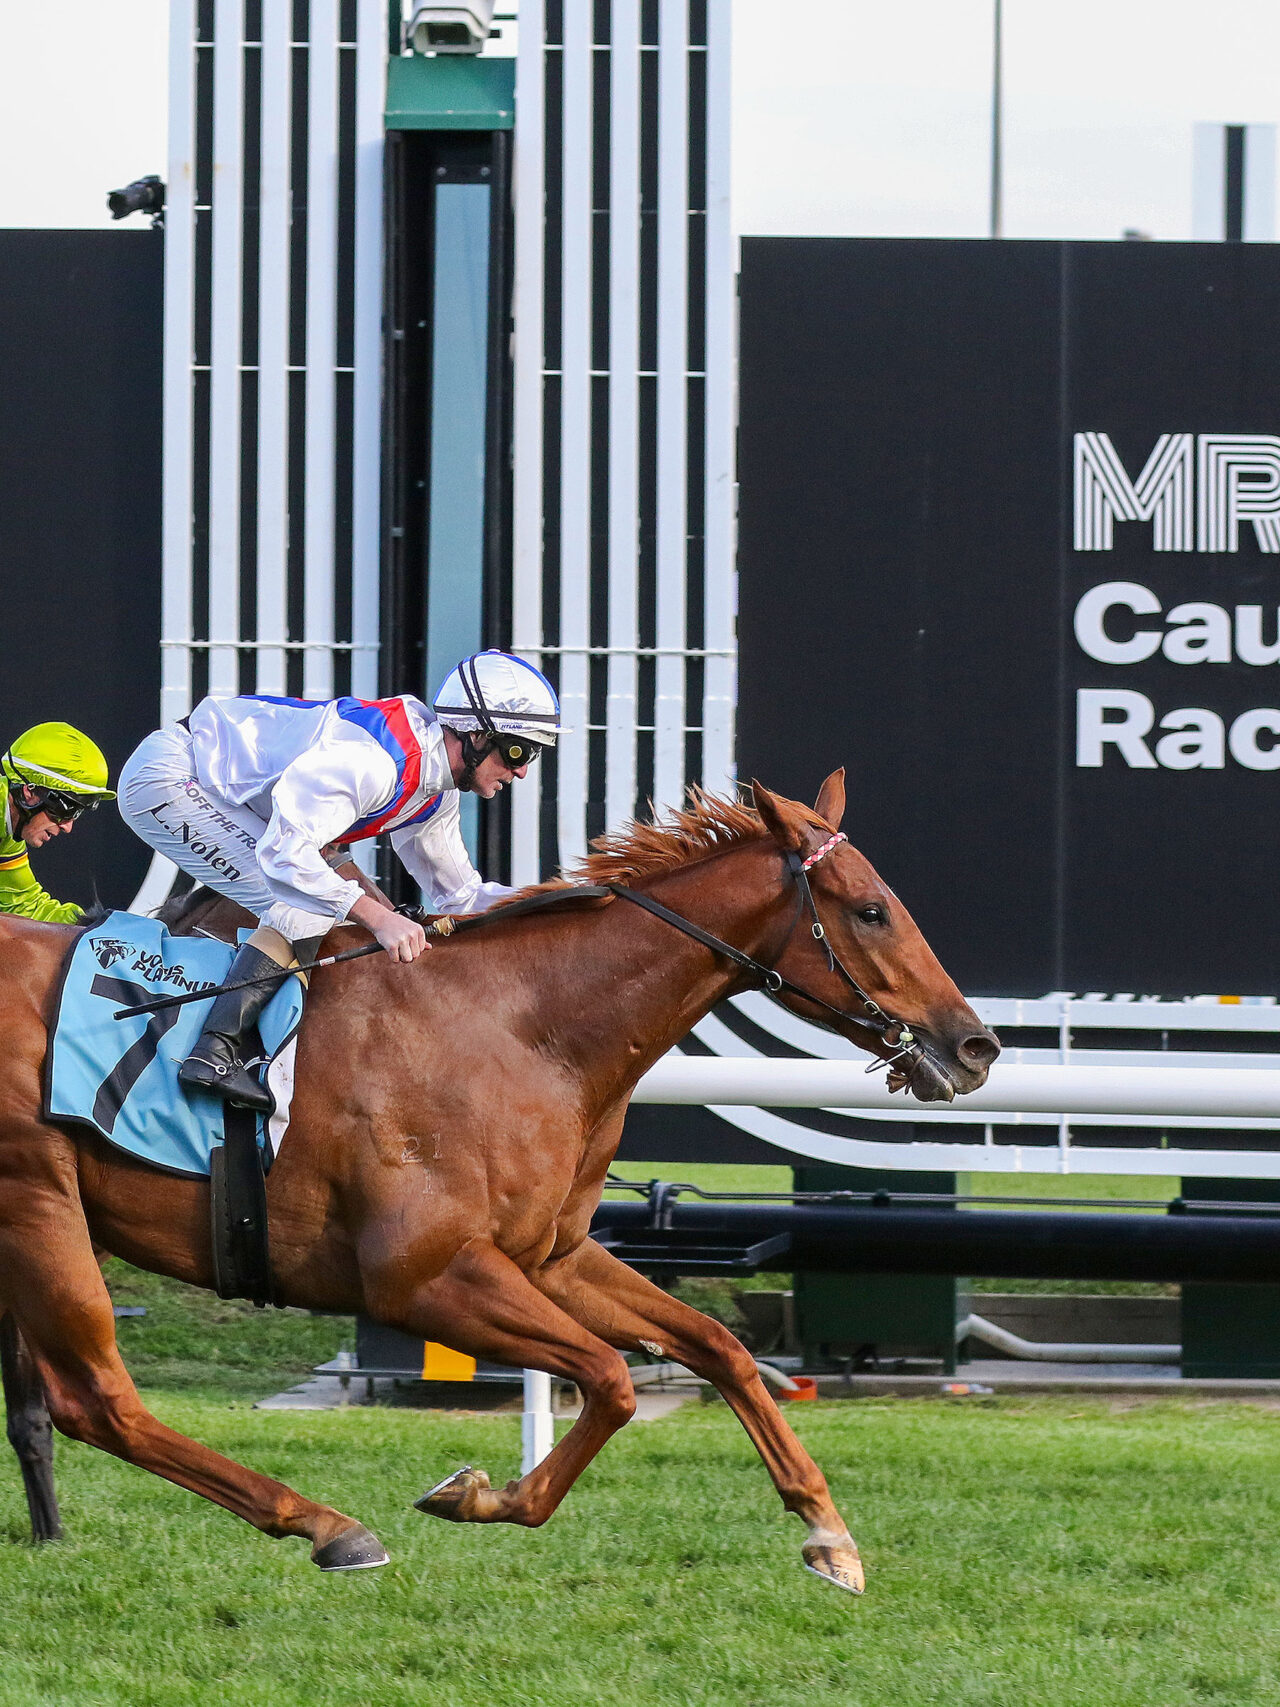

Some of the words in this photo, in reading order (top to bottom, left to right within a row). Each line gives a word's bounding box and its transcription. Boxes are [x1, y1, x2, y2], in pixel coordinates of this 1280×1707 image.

[1073, 431, 1280, 553] MR
[1076, 688, 1280, 771] Rac
[186, 787, 214, 812] OFF
[209, 809, 240, 833] THE
[140, 950, 185, 976] VOIS
[90, 973, 183, 1135] 7
